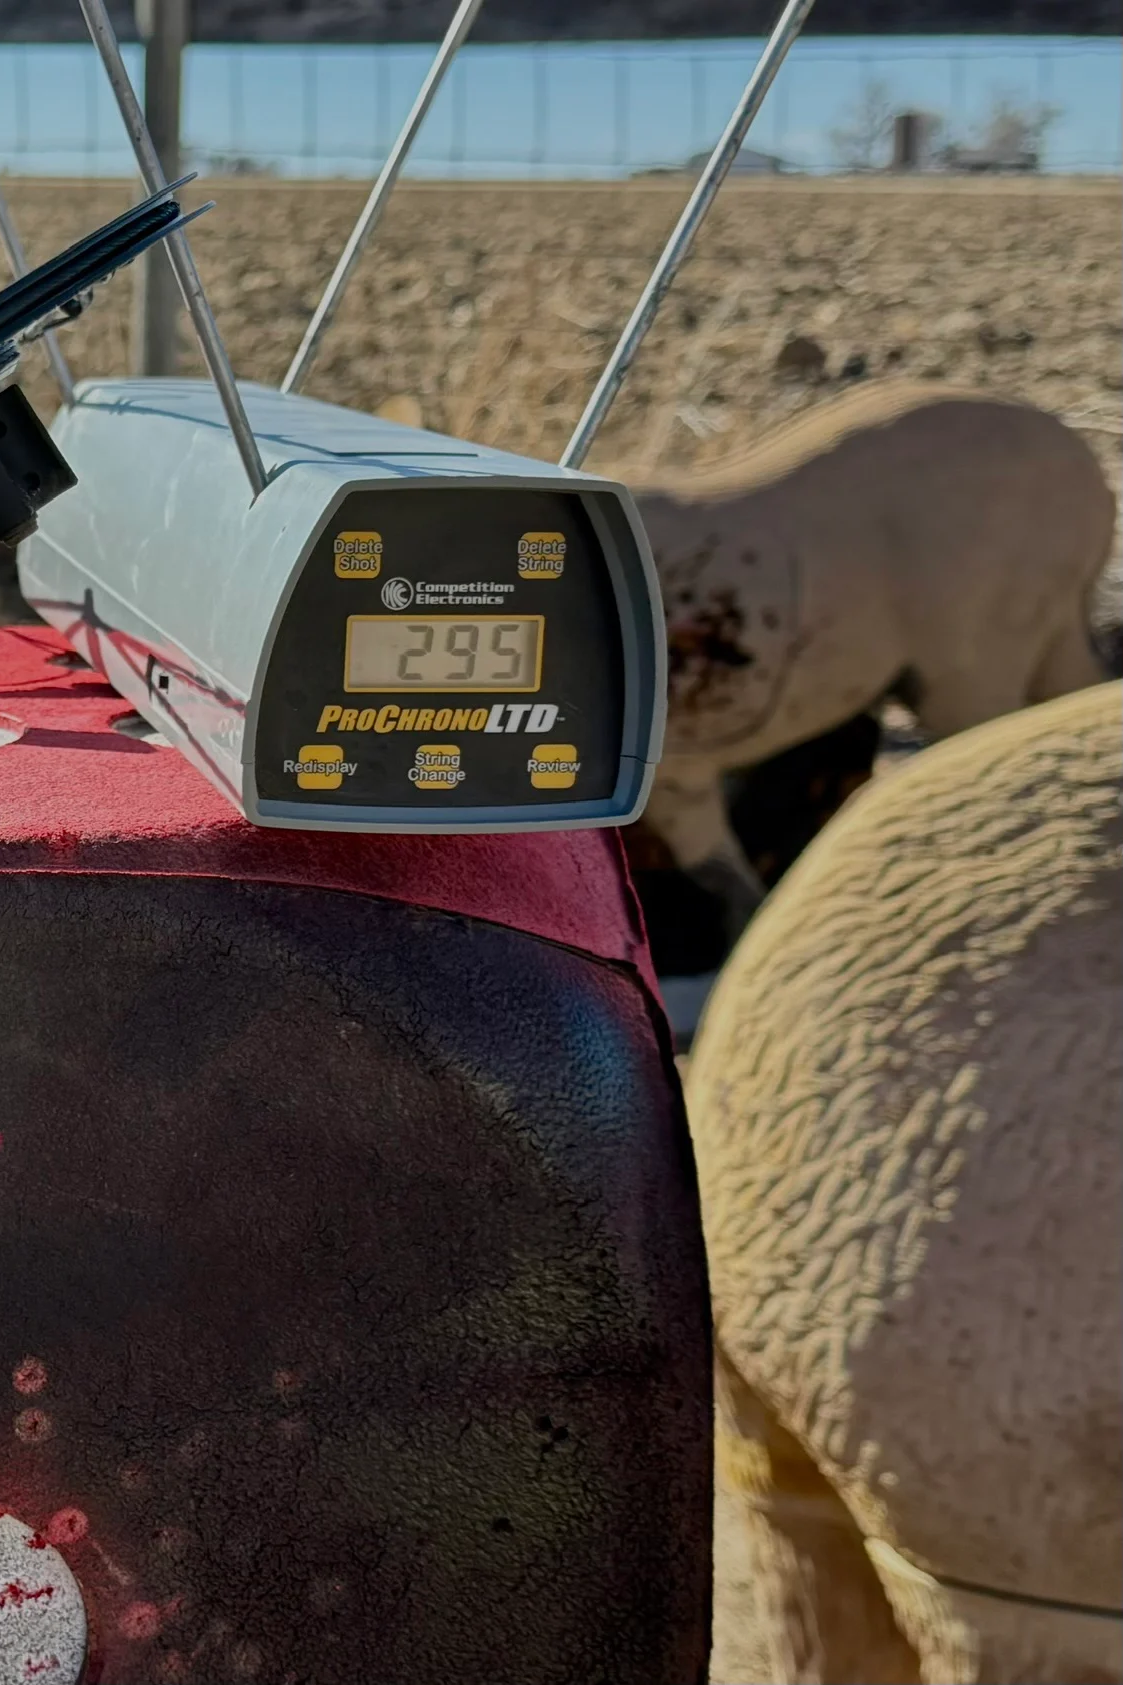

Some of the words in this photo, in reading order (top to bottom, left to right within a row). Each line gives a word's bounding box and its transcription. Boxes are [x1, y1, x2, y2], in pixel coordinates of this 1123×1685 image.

[333, 538, 383, 554] Delete
[517, 538, 567, 554] Delete
[339, 555, 377, 571] Shot
[517, 556, 565, 574] String
[416, 581, 515, 595] Competition
[416, 594, 505, 606] Electronics
[398, 624, 521, 681] 295
[283, 760, 358, 777] Redisplay
[414, 752, 461, 769] String
[527, 759, 581, 774] Review
[407, 768, 466, 785] Change
